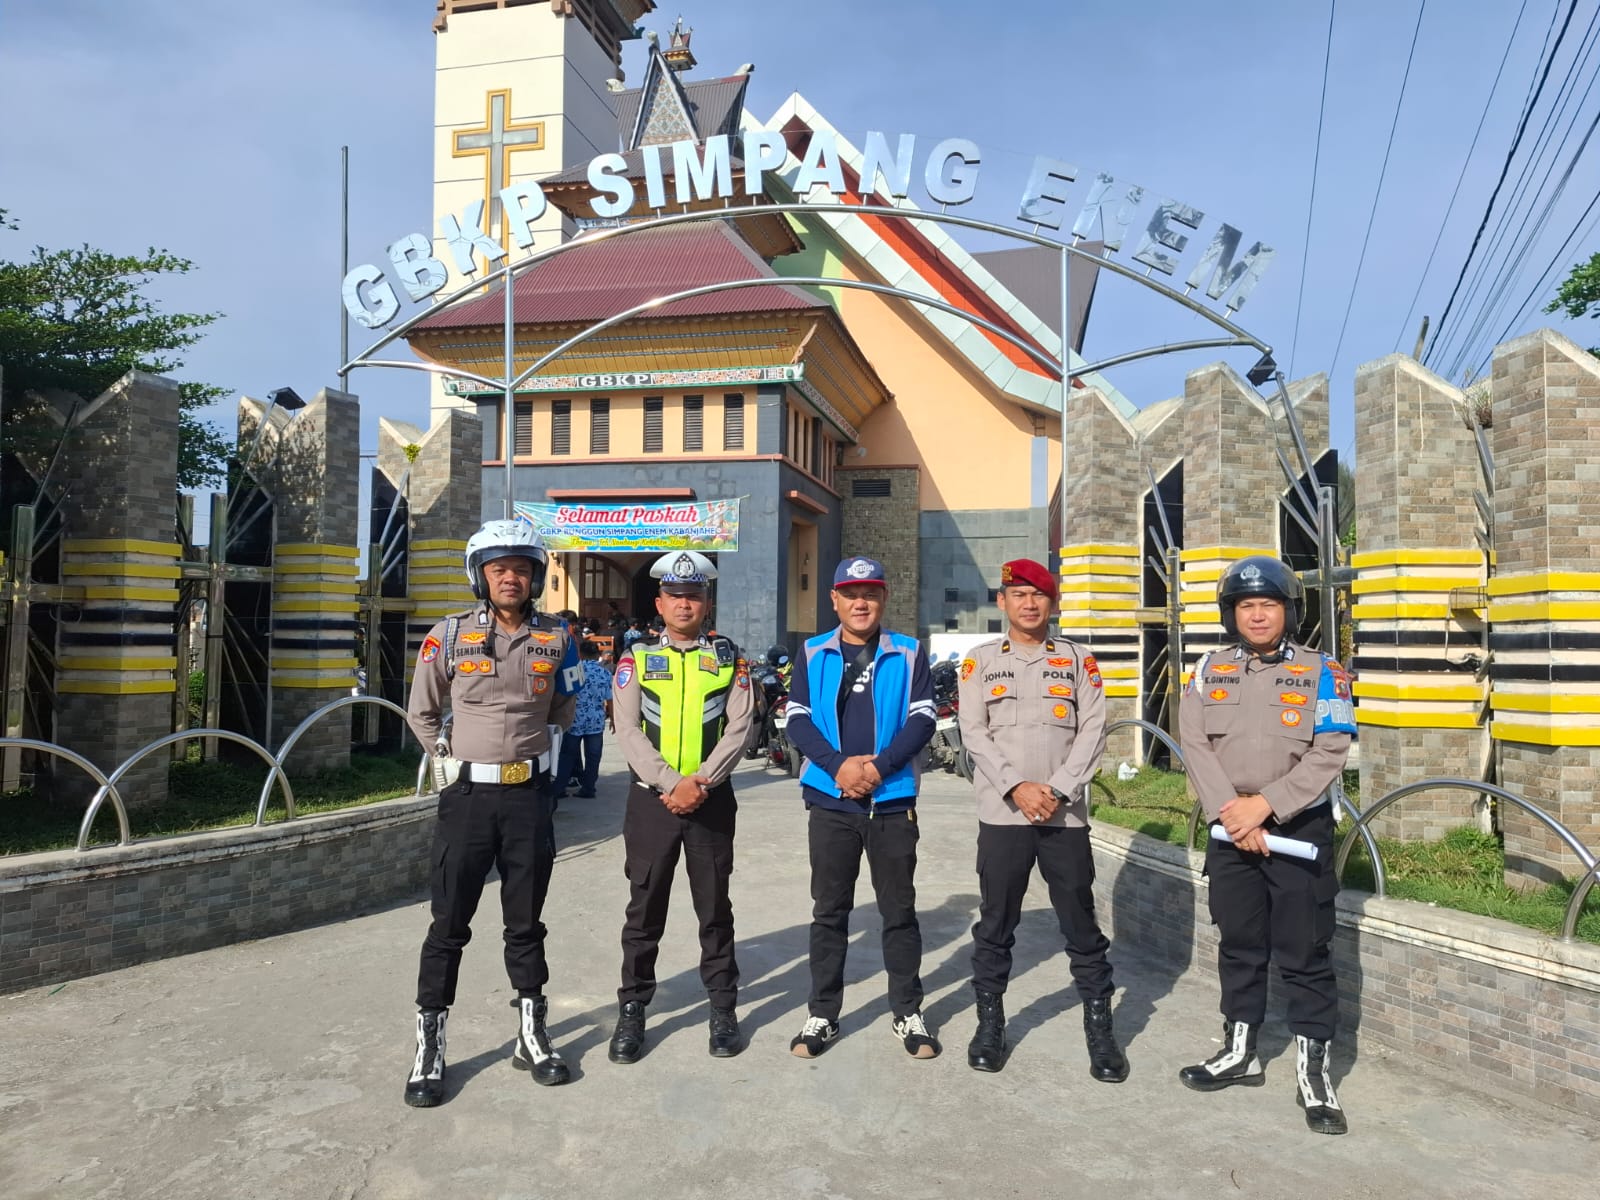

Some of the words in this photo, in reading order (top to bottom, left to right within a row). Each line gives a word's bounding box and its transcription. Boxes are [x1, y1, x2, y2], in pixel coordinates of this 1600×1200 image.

[342, 179, 547, 329] GBKP
[587, 131, 981, 218] SIMPANG
[1017, 154, 1277, 312] ENEM
[580, 374, 649, 387] GBKP
[557, 506, 629, 523] Selamat
[633, 505, 697, 523] Paskah
[527, 646, 560, 658] POLRI
[984, 671, 1015, 682] JOHAN
[1205, 676, 1240, 684] K.GINTING
[1275, 678, 1316, 688] POLRI
